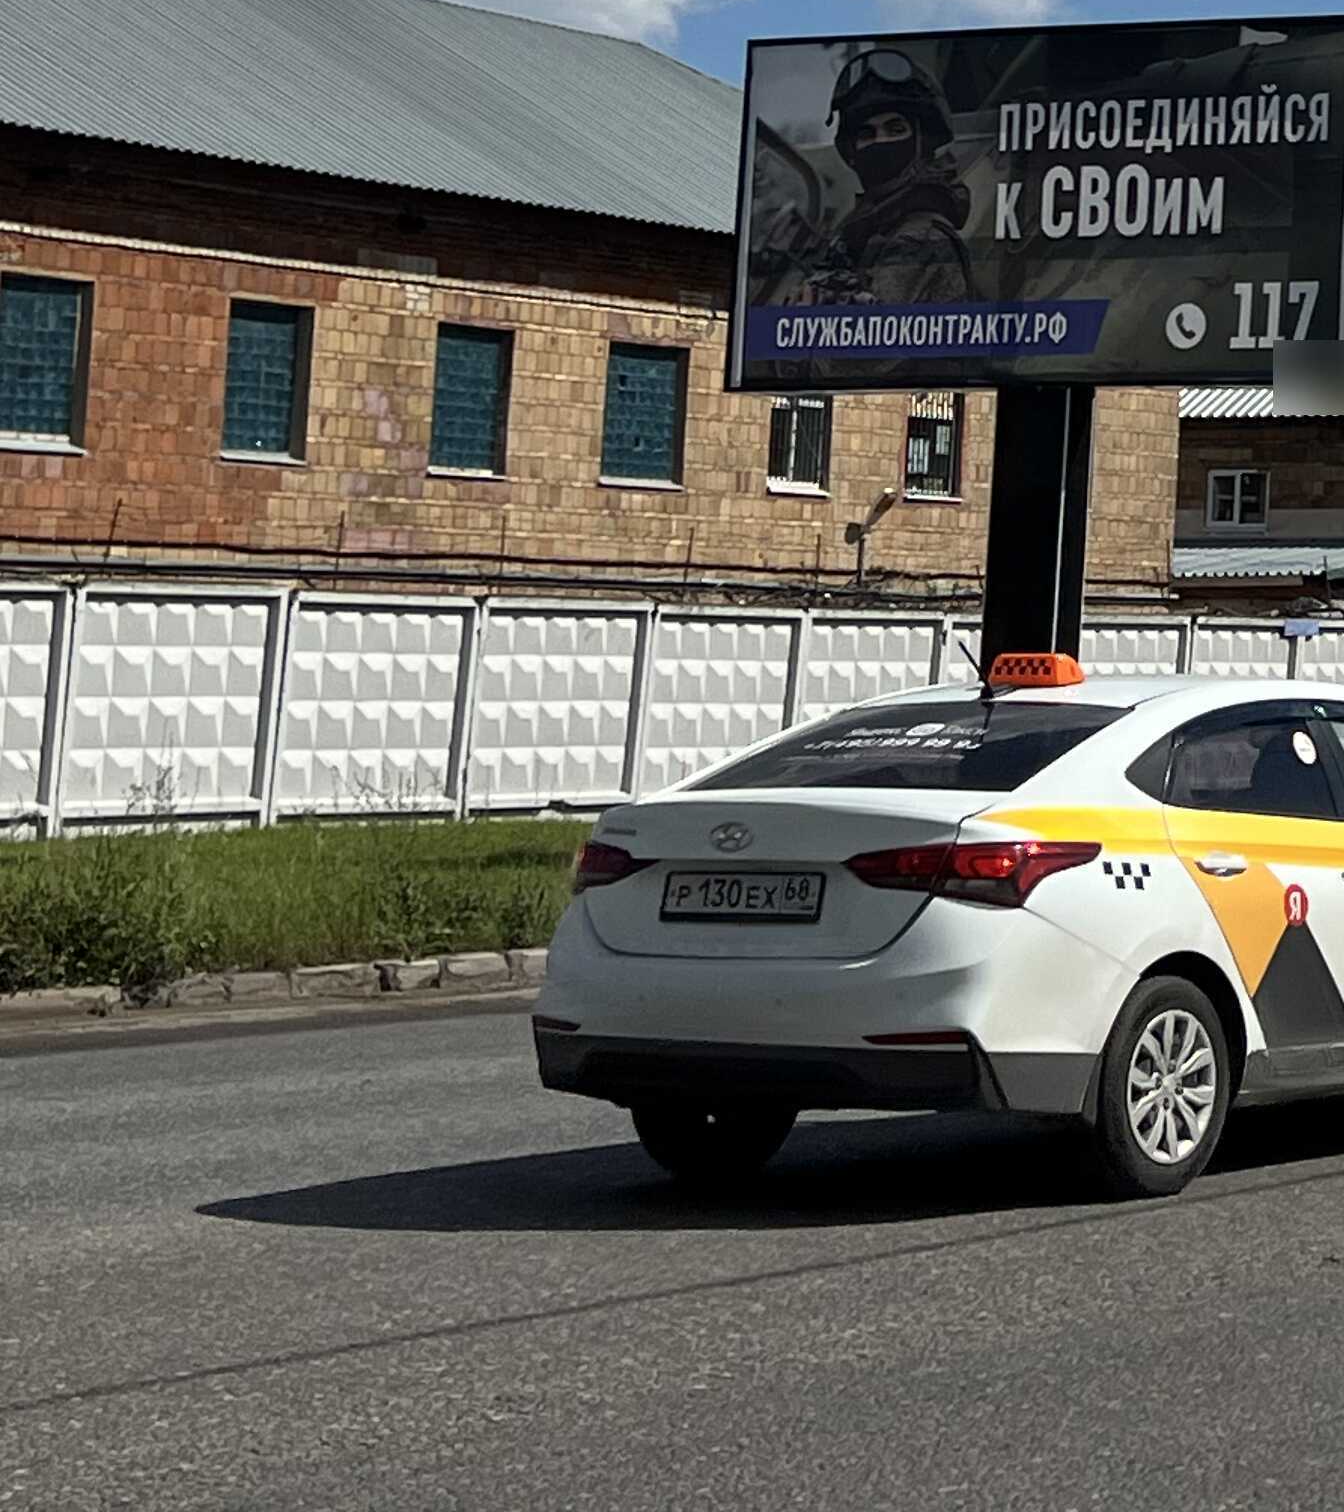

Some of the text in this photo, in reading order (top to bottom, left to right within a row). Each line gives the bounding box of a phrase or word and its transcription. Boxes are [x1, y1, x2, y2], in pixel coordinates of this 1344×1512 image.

[998, 84, 1330, 154] ПРИСОЕДИНЯЙСЯ
[775, 312, 1068, 348] СЛУЖБАПОКОНТРАКТУ.РФ
[1229, 281, 1320, 349] 117
[1289, 890, 1301, 920] Я
